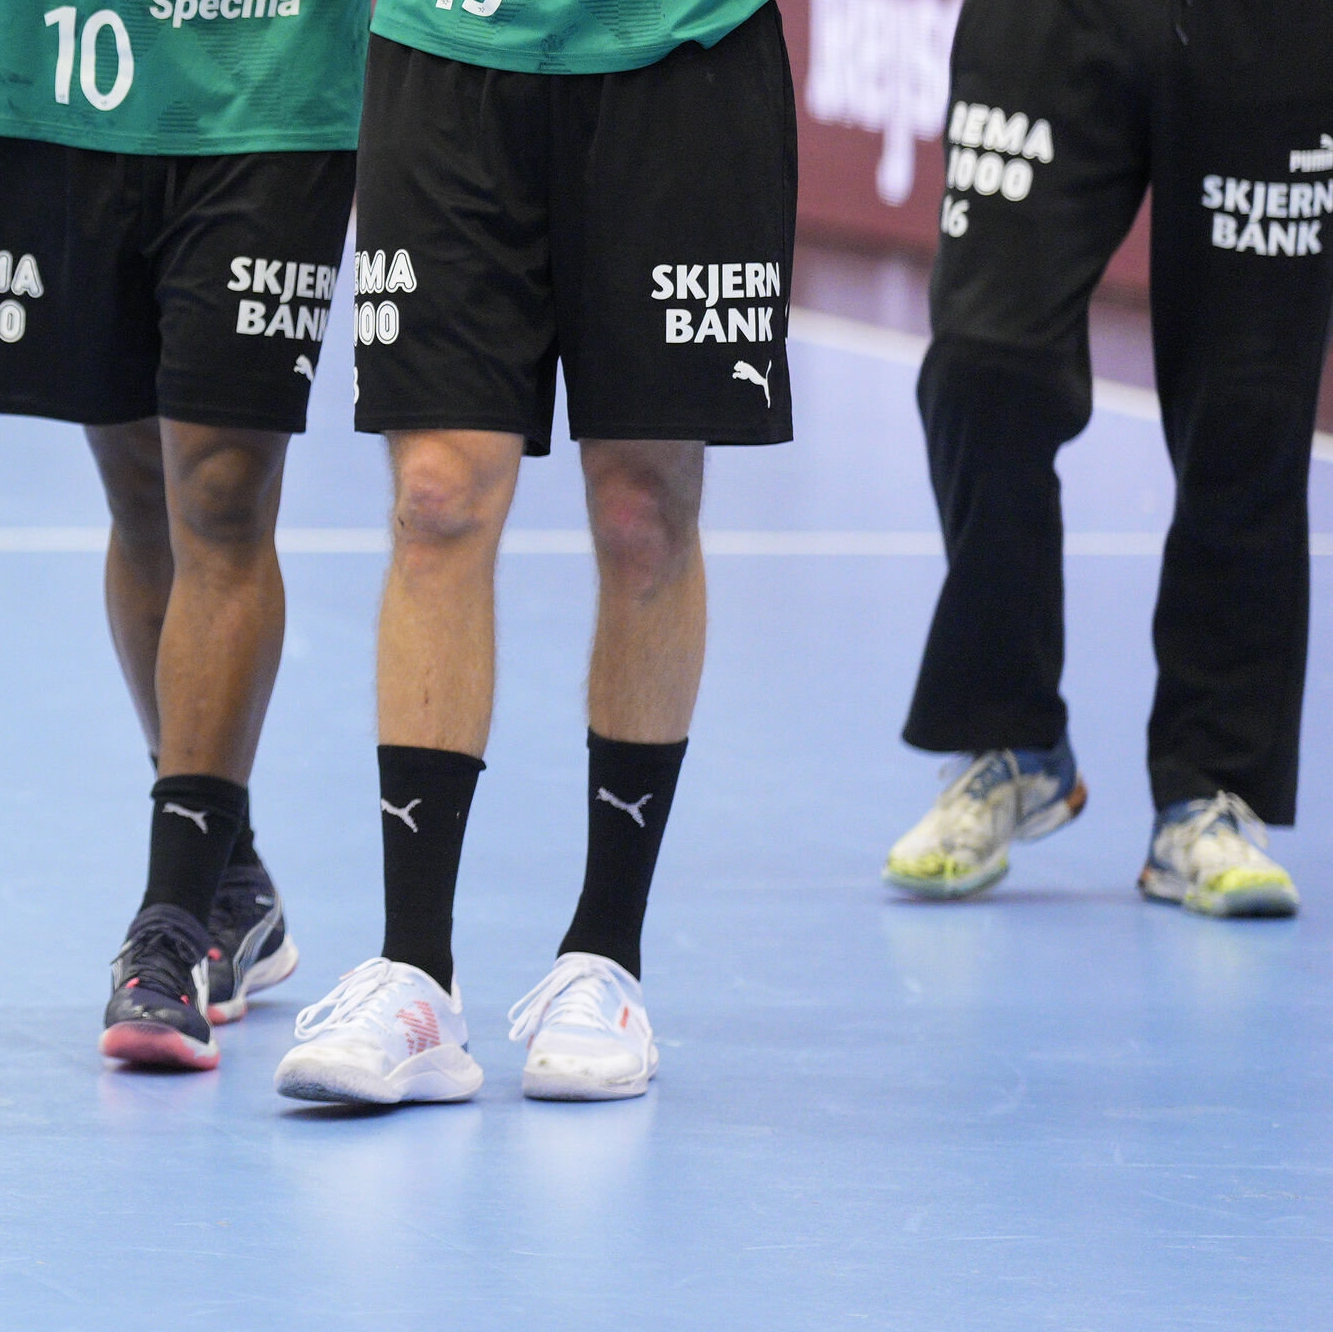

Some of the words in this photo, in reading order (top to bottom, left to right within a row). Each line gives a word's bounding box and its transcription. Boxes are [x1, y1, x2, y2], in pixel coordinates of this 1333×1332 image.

[44, 6, 135, 111] 10
[1201, 174, 1333, 223] SKJERN
[1212, 211, 1323, 257] BANK
[227, 256, 338, 304] SKJER
[354, 248, 418, 295] MA
[651, 261, 781, 308] SKJERN
[665, 306, 774, 344] BANK
